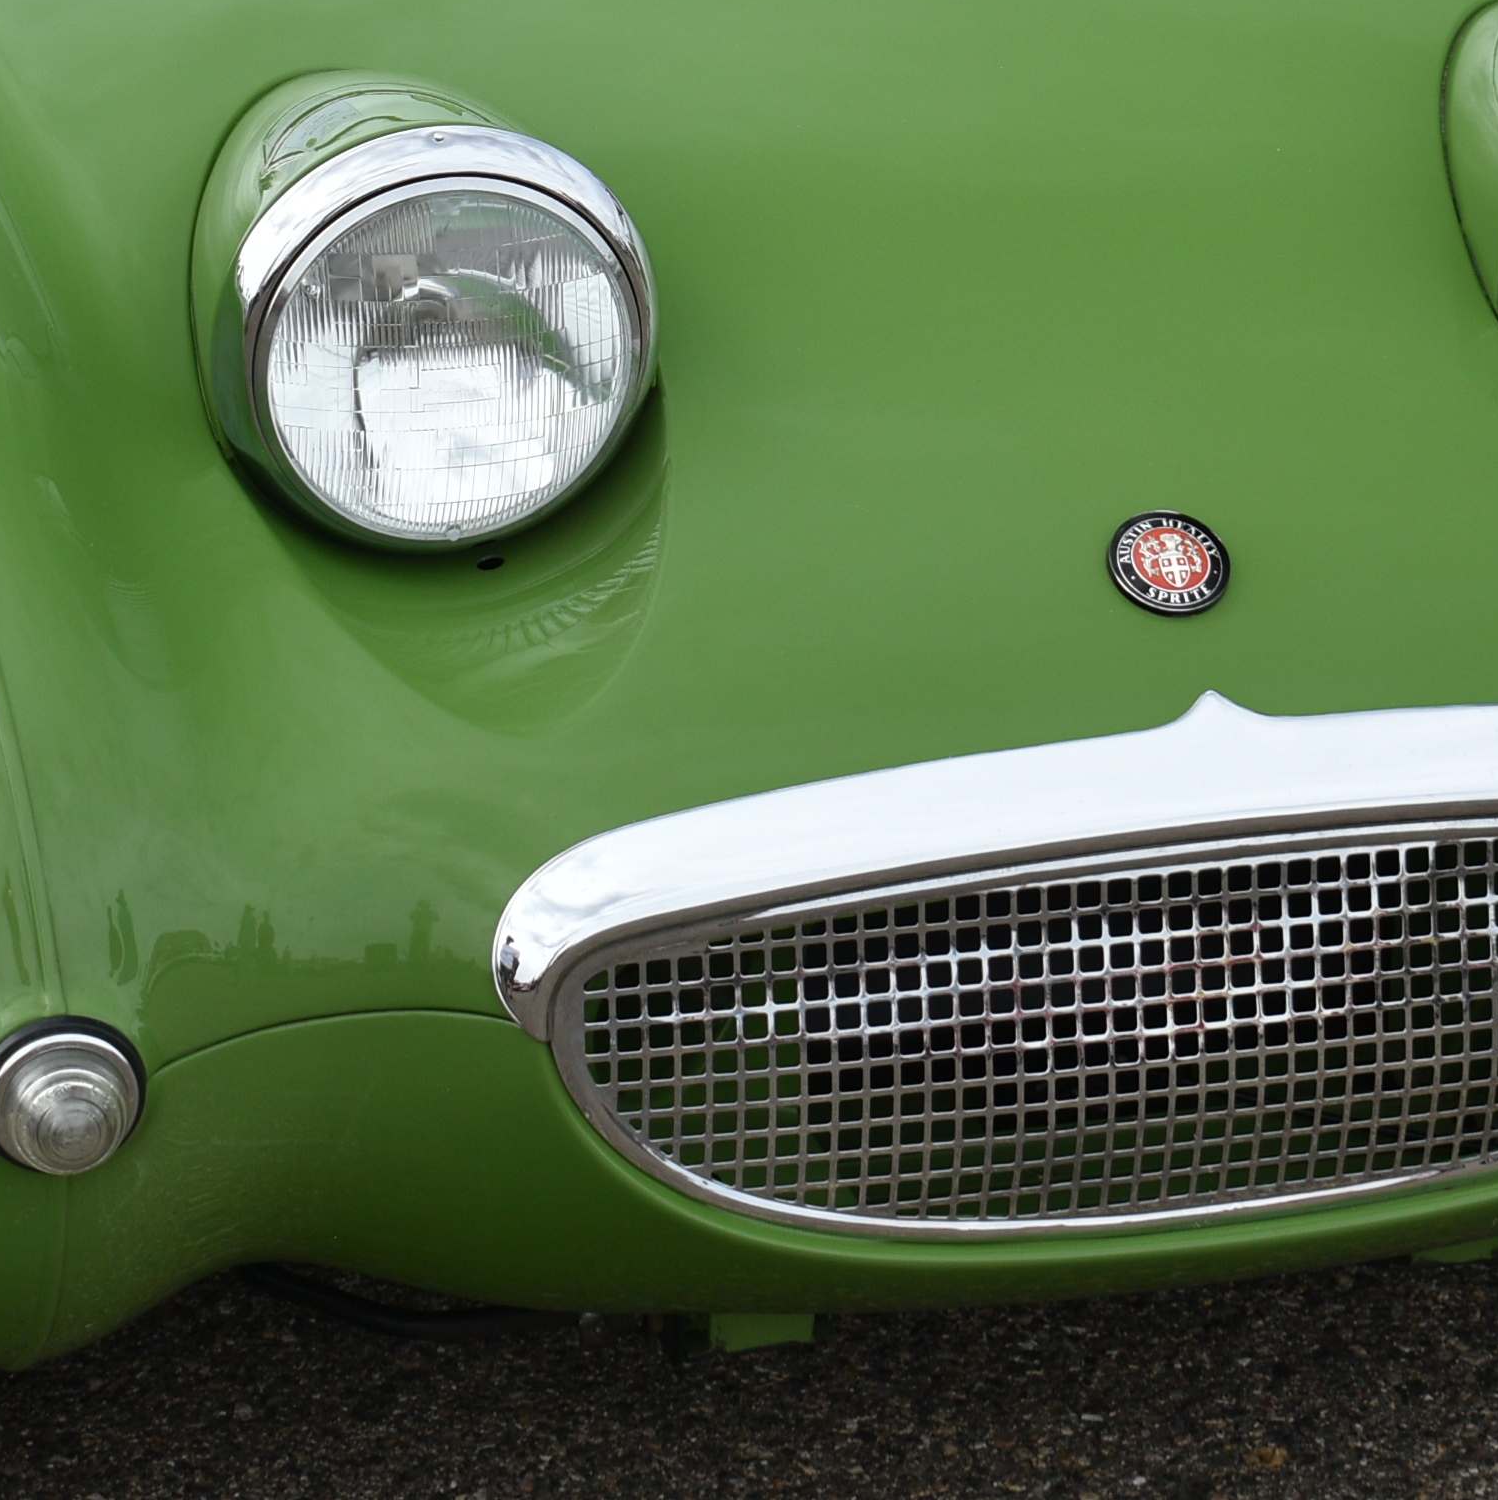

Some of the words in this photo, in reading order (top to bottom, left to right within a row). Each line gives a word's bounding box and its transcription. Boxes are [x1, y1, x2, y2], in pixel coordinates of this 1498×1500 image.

[1119, 521, 1153, 564] AUSTIN
[1161, 518, 1220, 558] HEALEY
[1146, 583, 1212, 604] SPRITE
